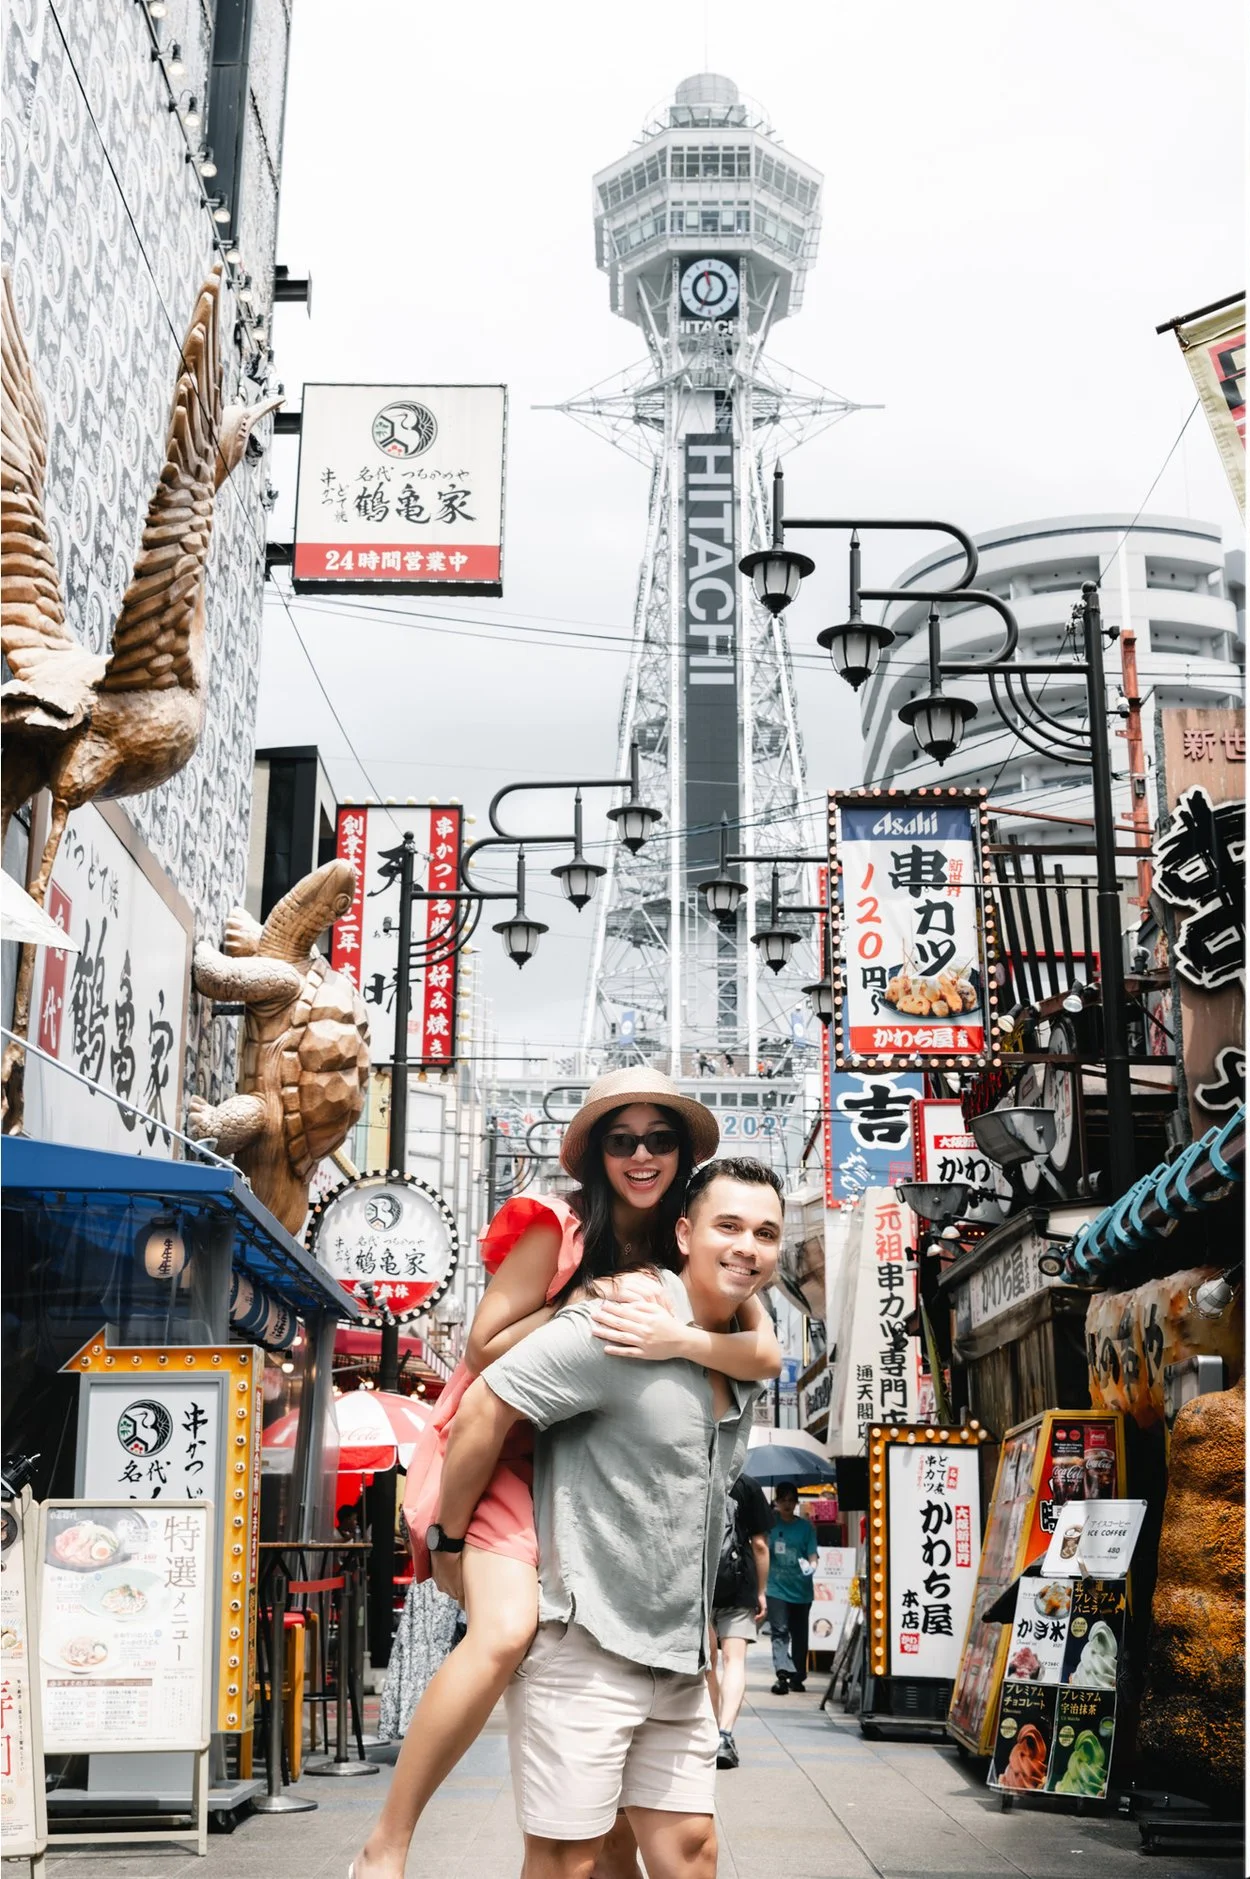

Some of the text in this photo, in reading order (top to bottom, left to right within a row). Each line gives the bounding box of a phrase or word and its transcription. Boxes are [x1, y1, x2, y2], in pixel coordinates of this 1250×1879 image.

[325, 550, 469, 572] 24時間営業中
[687, 442, 735, 685] HITACHI
[872, 811, 939, 836] Asahi
[888, 844, 957, 977] 串カツ
[873, 1028, 955, 1049] かわち屋
[118, 1459, 171, 1484] 名代
[1087, 1529, 1127, 1537] ICE COFFEE
[919, 1499, 954, 1637] かわち屋
[163, 1515, 200, 1662] 特選メニュー
[902, 1589, 919, 1630] 本店
[1017, 1618, 1066, 1642] かき氷
[1006, 1684, 1044, 1697] プレミアム
[1061, 1690, 1102, 1702] プレミアム
[1004, 1696, 1046, 1710] チョコレート
